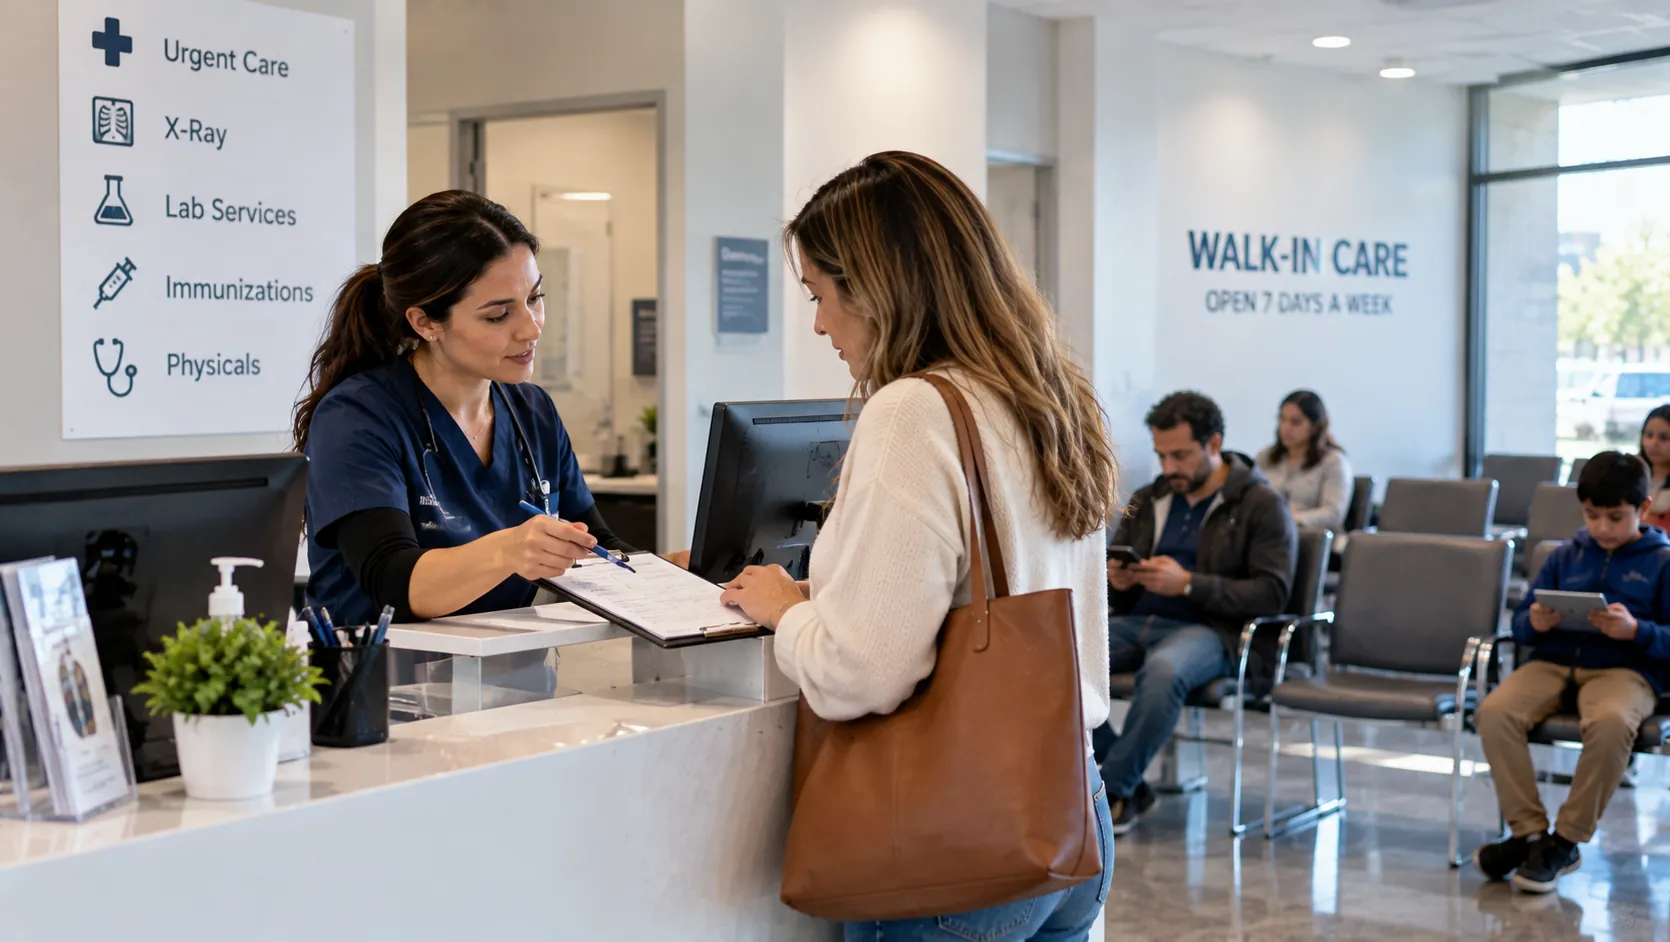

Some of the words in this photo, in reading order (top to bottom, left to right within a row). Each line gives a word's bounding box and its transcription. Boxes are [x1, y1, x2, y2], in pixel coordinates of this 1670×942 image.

[164, 38, 237, 72] Urgent
[242, 50, 290, 78] Care
[164, 115, 228, 151] X-Ray
[165, 194, 205, 220] Lab
[211, 197, 297, 226] Services
[1187, 229, 1321, 274] WALK-IN
[1332, 239, 1409, 278] CARE
[165, 275, 314, 303] Immunizations
[1205, 289, 1257, 313] OPEN
[1262, 290, 1273, 312] 7
[1277, 291, 1323, 314] DAYS
[1328, 292, 1342, 313] A
[1346, 293, 1393, 315] WEEK
[166, 352, 261, 382] Physicals
